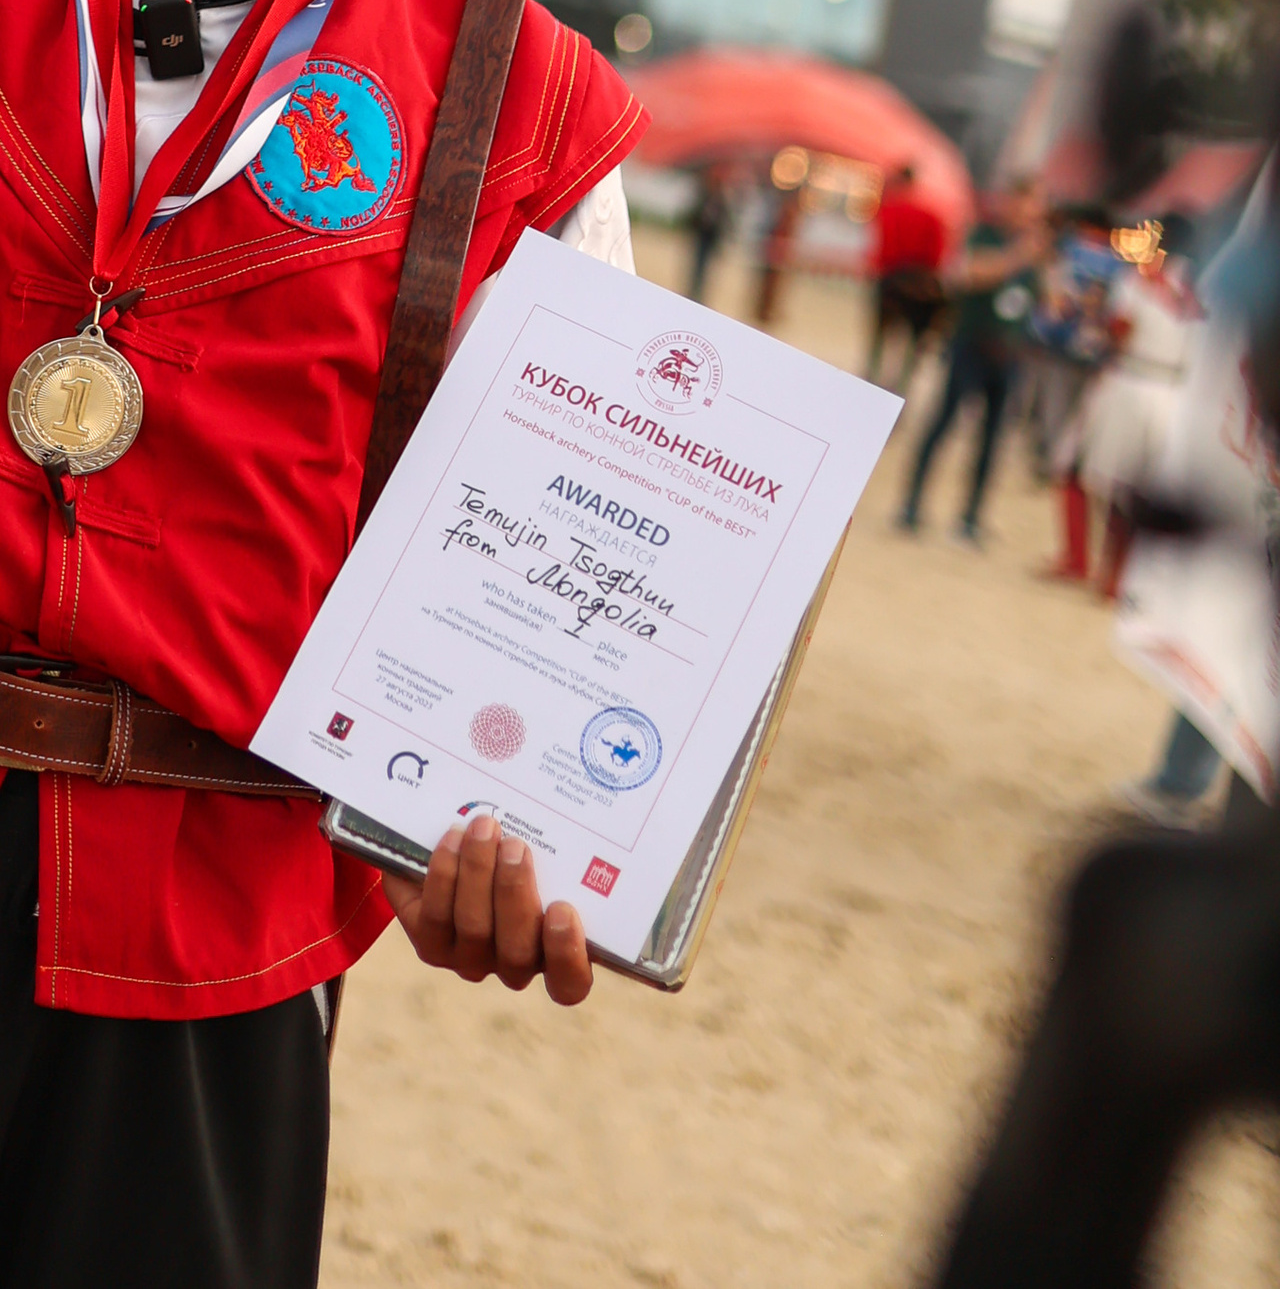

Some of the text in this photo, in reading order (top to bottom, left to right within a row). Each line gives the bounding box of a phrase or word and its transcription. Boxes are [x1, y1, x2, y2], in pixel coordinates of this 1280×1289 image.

[340, 156, 402, 229] ASSOCIATION
[52, 376, 93, 437] 1
[520, 362, 782, 503] КУБОК СИЛЬНЕЙШИХ
[502, 408, 755, 538] Horseback archery Competition "CUP of the BEST"
[511, 383, 768, 522] ТУРНИР ПО КОННОЙ СТРЕЛЬБЕ ИЗ ЛУКА
[459, 482, 547, 551] Temujin
[538, 499, 657, 567] НАГРАЖДАЕТСЯ
[546, 474, 669, 546] AWARDED
[442, 518, 658, 641] from Mongolia
[421, 606, 430, 614] на
[432, 609, 463, 631] Турнире
[463, 628, 473, 637] по
[474, 634, 502, 652] конной
[503, 650, 538, 671] стрельбе
[538, 669, 548, 677] из
[548, 674, 566, 687] лука
[445, 606, 454, 614] at
[454, 609, 491, 634] Horseback
[492, 631, 520, 650] archery
[520, 644, 566, 673] Competition
[596, 684, 609, 696] the
[481, 579, 504, 596] who
[506, 590, 525, 607] has
[526, 602, 556, 624] taken
[596, 641, 627, 661] place
[483, 597, 619, 670] занявший(ая) место
[375, 648, 453, 695] Центр национальных
[375, 674, 433, 709] 27 августа 2023
[376, 663, 442, 701] конных традиций
[384, 692, 413, 712] Москва
[397, 773, 420, 788] ЦНКТ
[541, 750, 581, 777] Equestrian
[554, 784, 585, 806] Moscow
[556, 773, 566, 781] of
[565, 777, 593, 797] August
[500, 819, 530, 840] КОННОГО
[530, 837, 556, 854] СПОРТА
[503, 812, 543, 836] ФЕДЕРАЦИЯ
